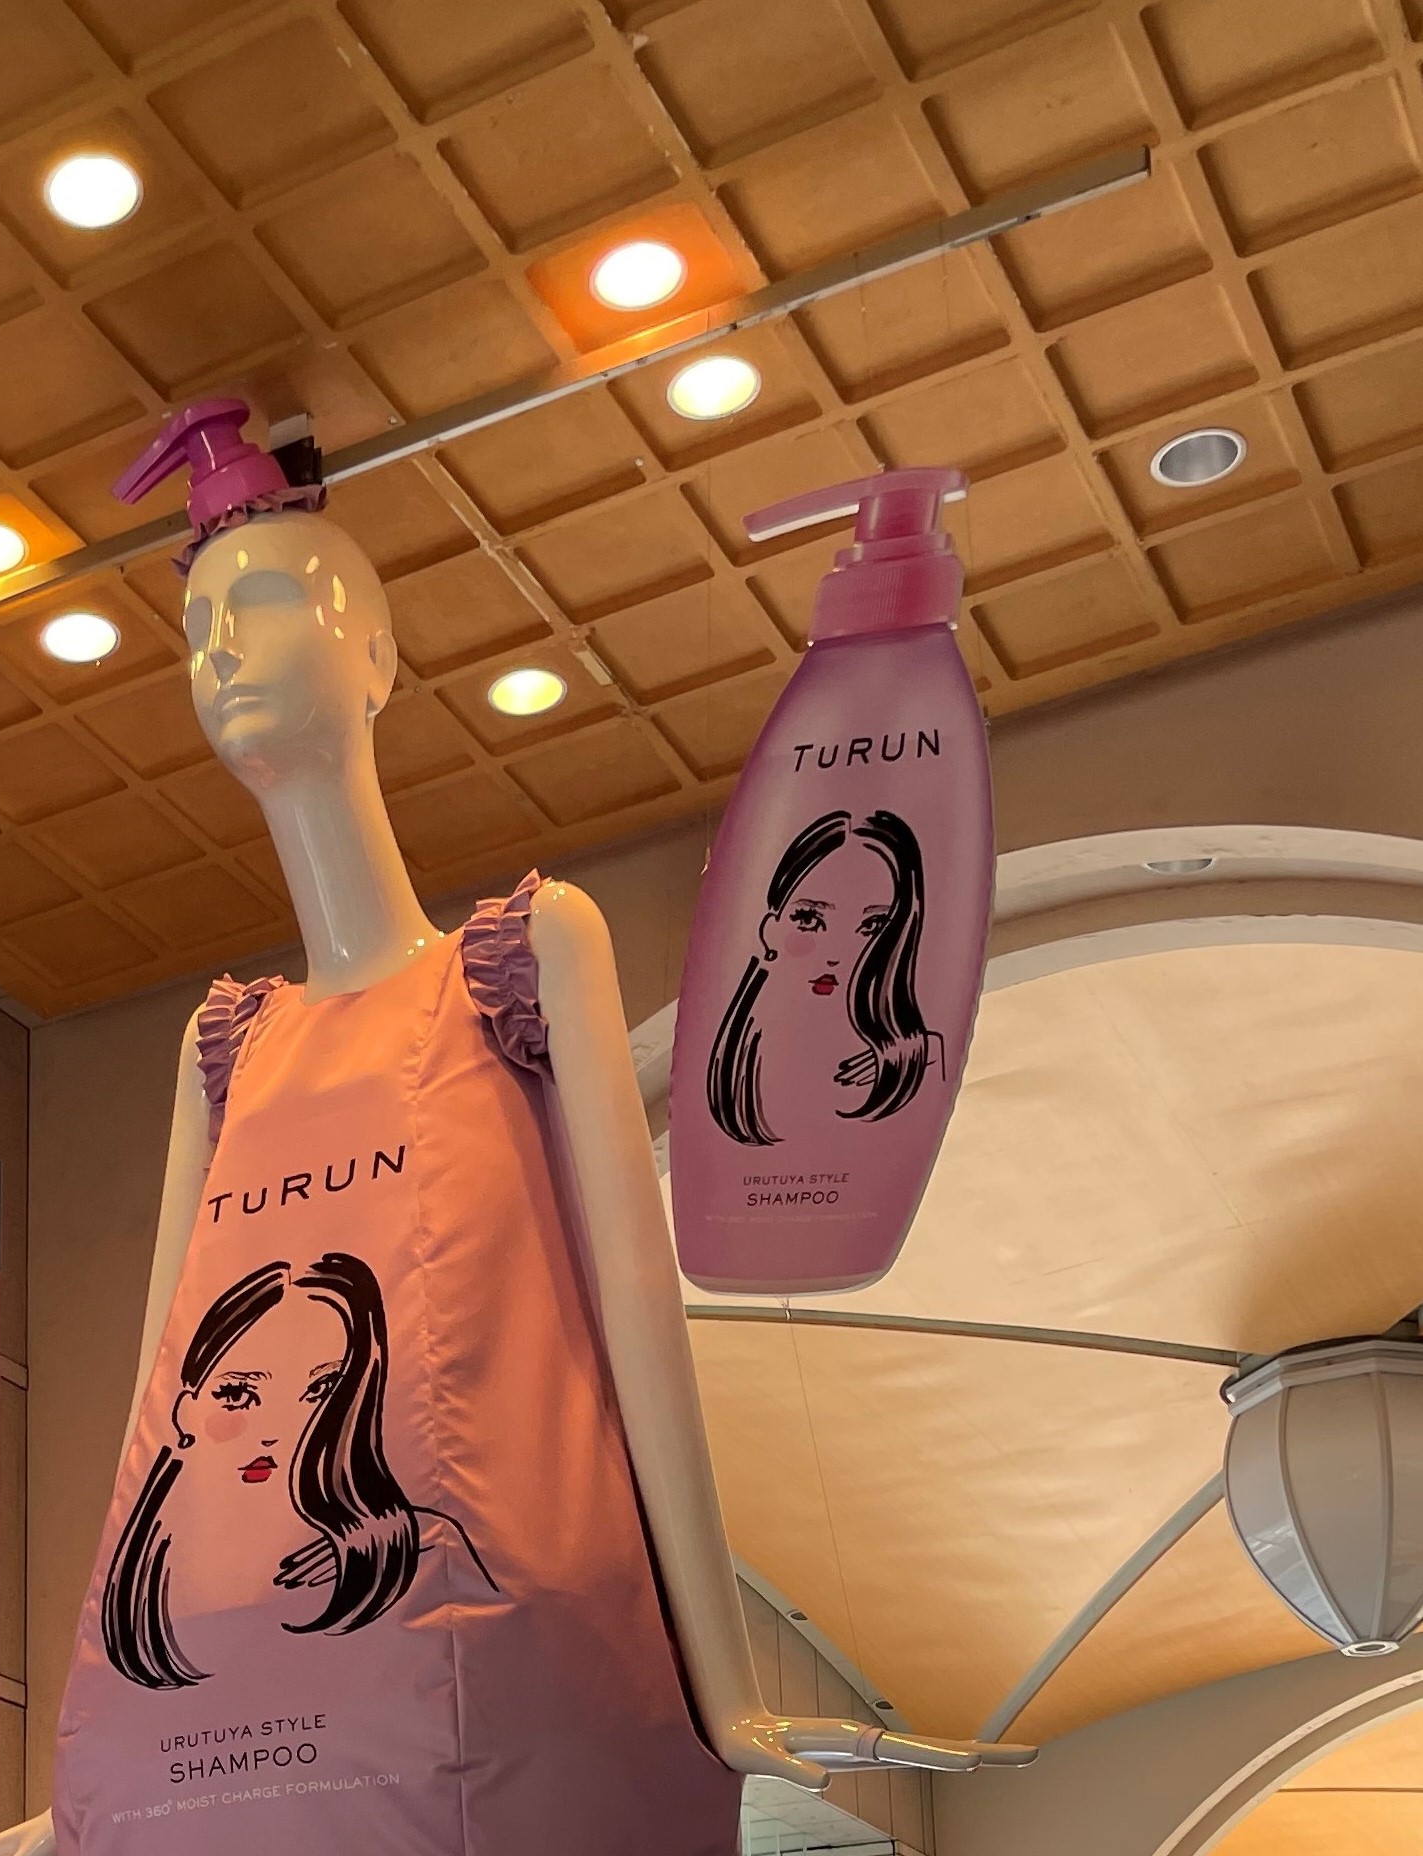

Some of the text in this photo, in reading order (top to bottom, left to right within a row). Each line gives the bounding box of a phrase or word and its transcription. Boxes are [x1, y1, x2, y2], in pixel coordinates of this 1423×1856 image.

[794, 729, 940, 772] TURUN
[208, 1145, 405, 1223] TURUN
[743, 1173, 850, 1186] URUTUYA STYLE
[747, 1190, 839, 1206] SHAMPOO
[161, 1714, 326, 1753] URUTUYA STYLE
[170, 1743, 317, 1783] SHAMPOO
[111, 1809, 142, 1824] WITH
[176, 1793, 217, 1811] MOIST
[221, 1785, 281, 1804] CHARGE
[286, 1773, 400, 1795] FORMULATION
